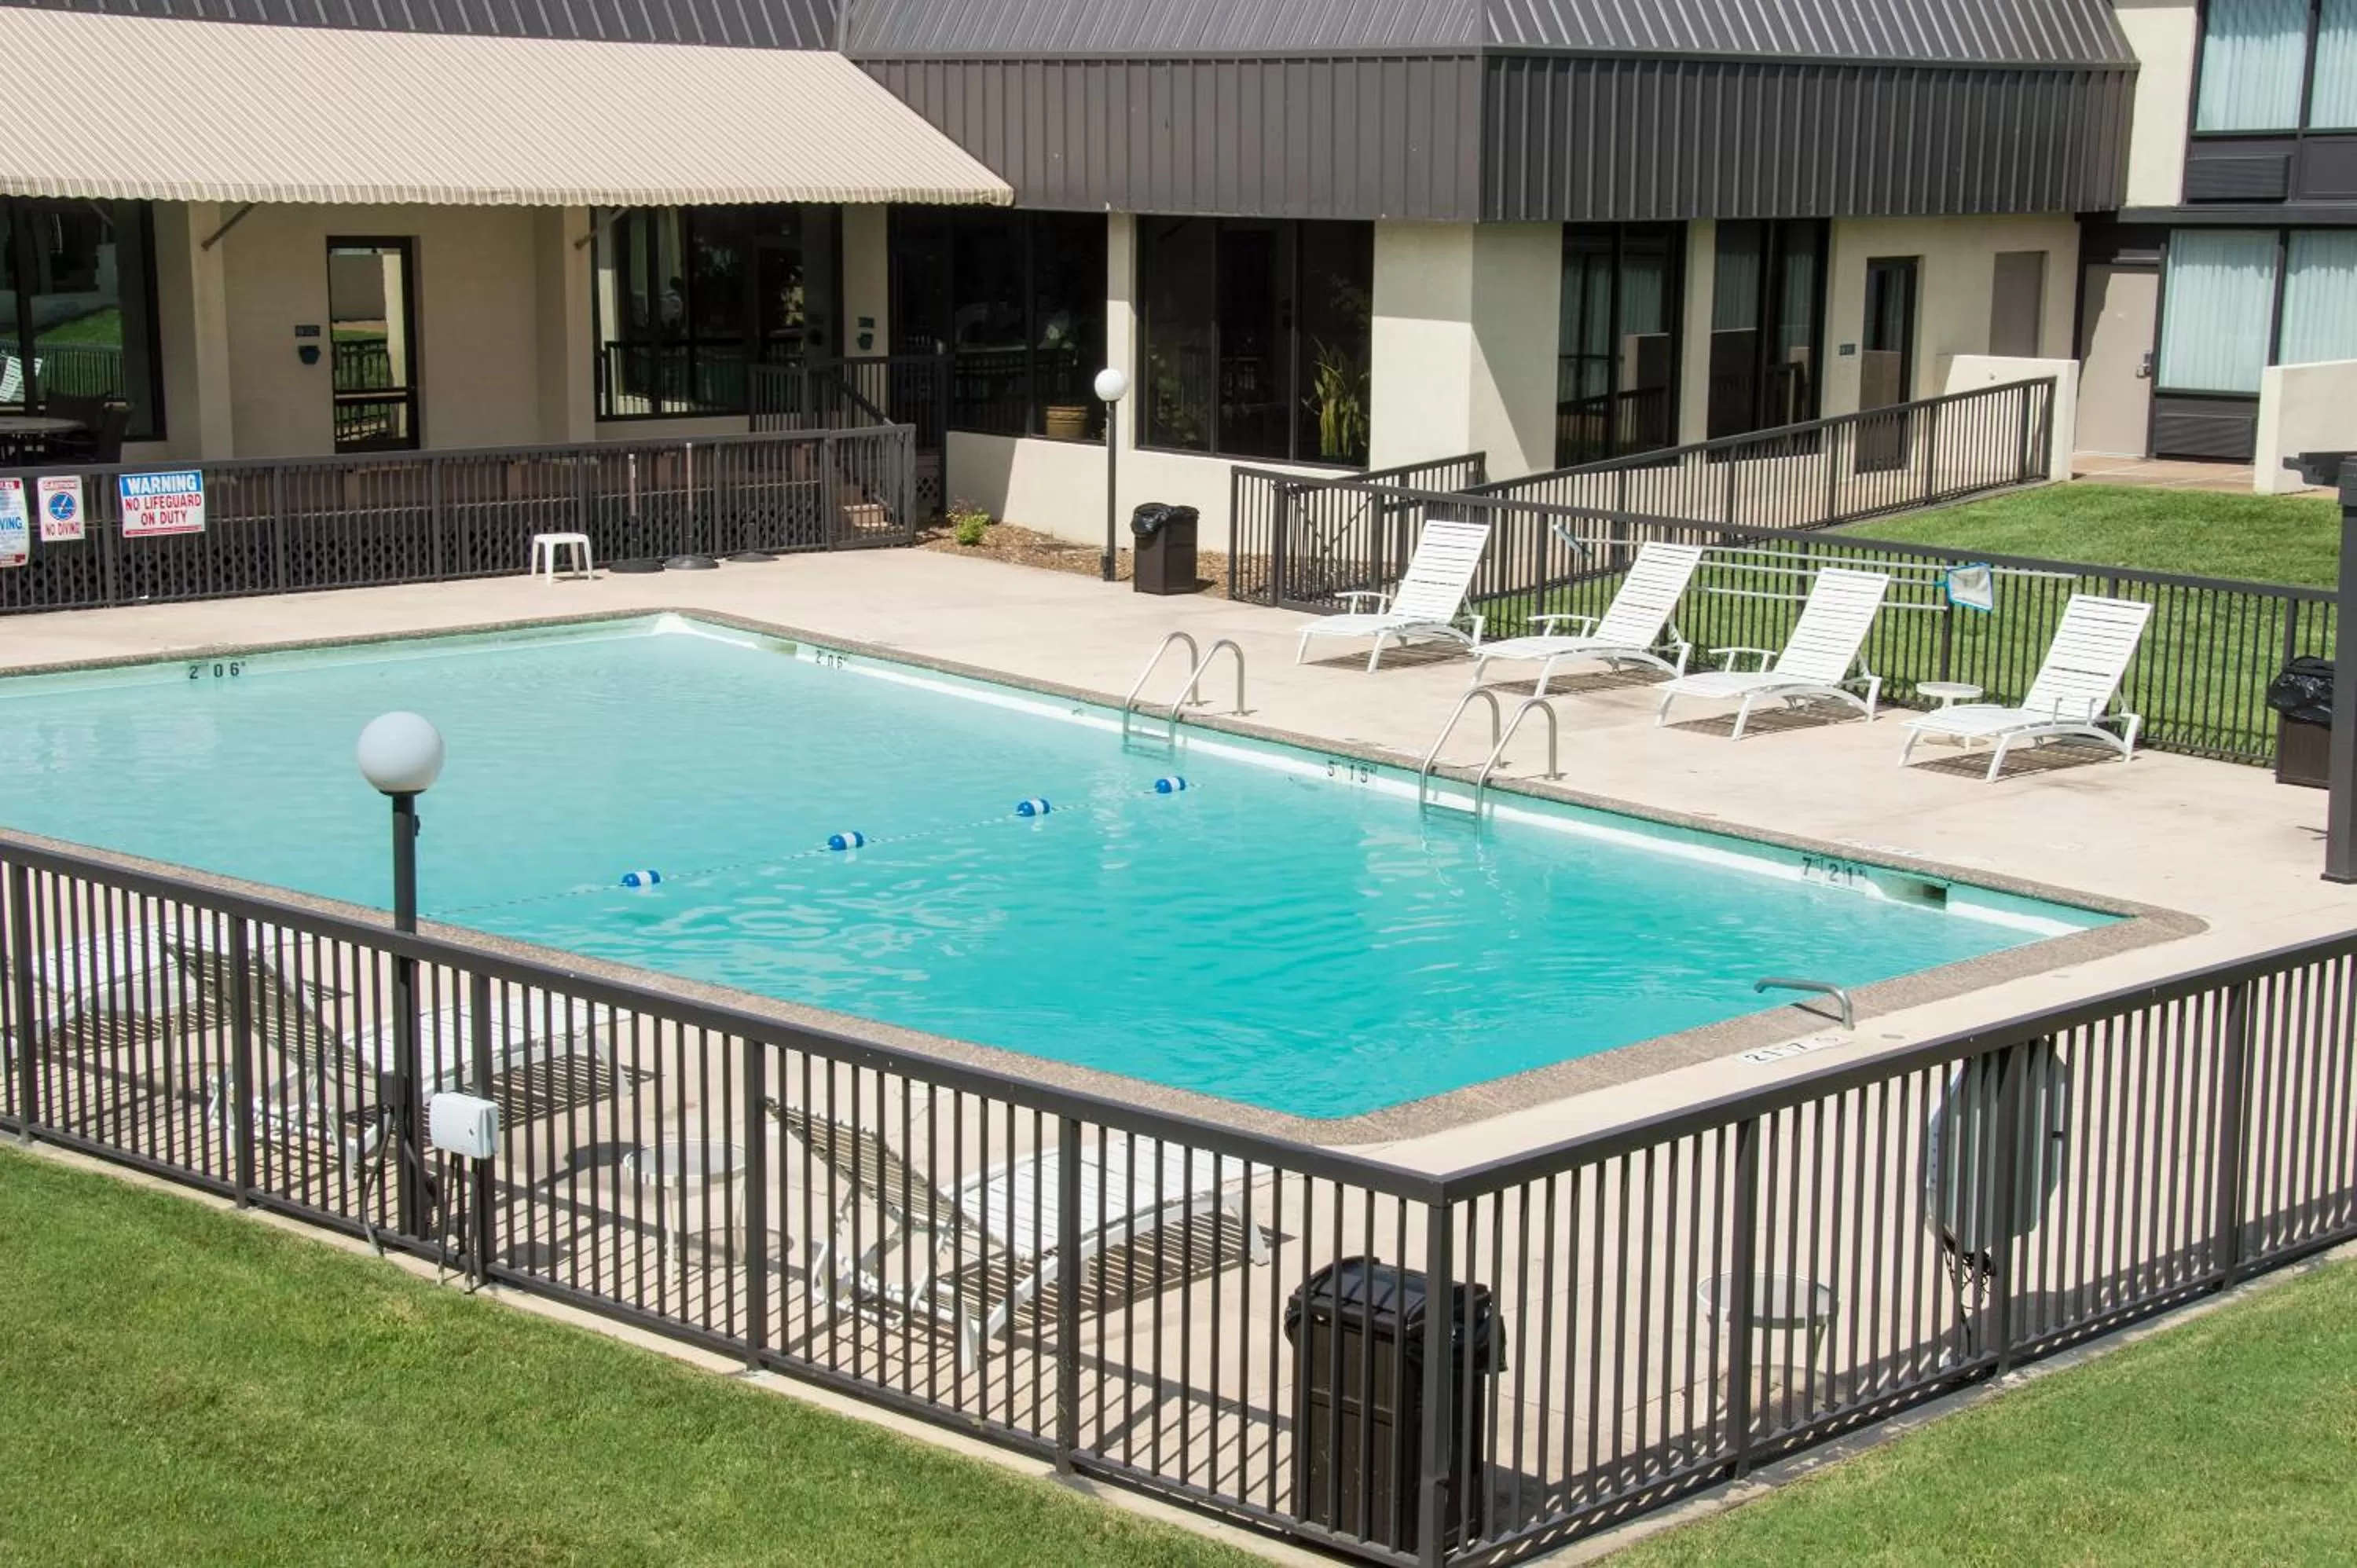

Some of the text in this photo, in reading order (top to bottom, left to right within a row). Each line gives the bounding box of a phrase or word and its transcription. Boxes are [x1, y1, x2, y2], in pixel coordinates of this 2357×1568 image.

[127, 474, 197, 495] WARNING
[126, 493, 202, 511] NO LIFEGUARD
[141, 510, 187, 526] ON DUTY
